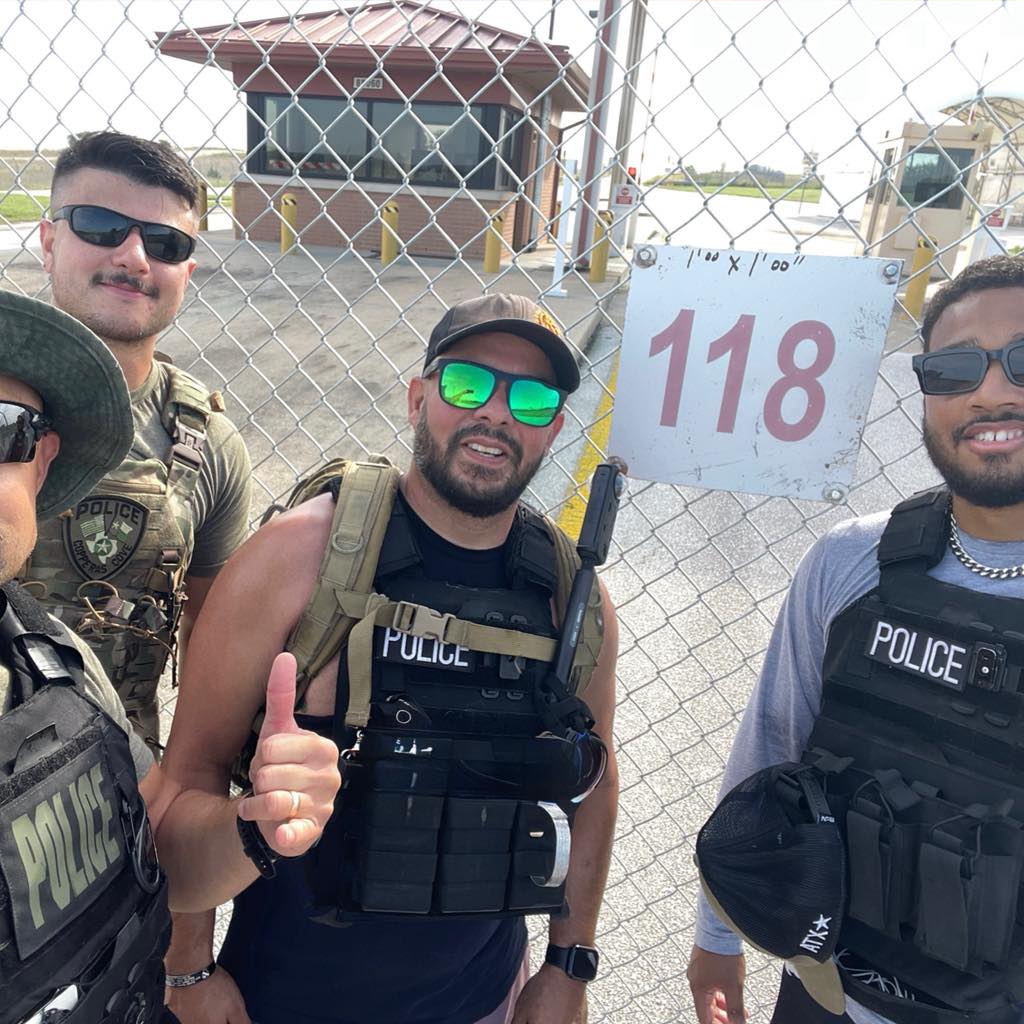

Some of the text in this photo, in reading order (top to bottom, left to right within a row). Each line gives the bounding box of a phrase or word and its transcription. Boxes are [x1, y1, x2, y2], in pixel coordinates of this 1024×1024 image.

[648, 308, 836, 443] 118
[75, 500, 141, 525] POLICE
[73, 539, 108, 574] COPPERAS
[111, 543, 133, 567] COVE
[382, 626, 470, 667] POLICE
[869, 620, 967, 685] POLICE
[11, 762, 121, 929] POLICE
[799, 929, 829, 954] ATX
